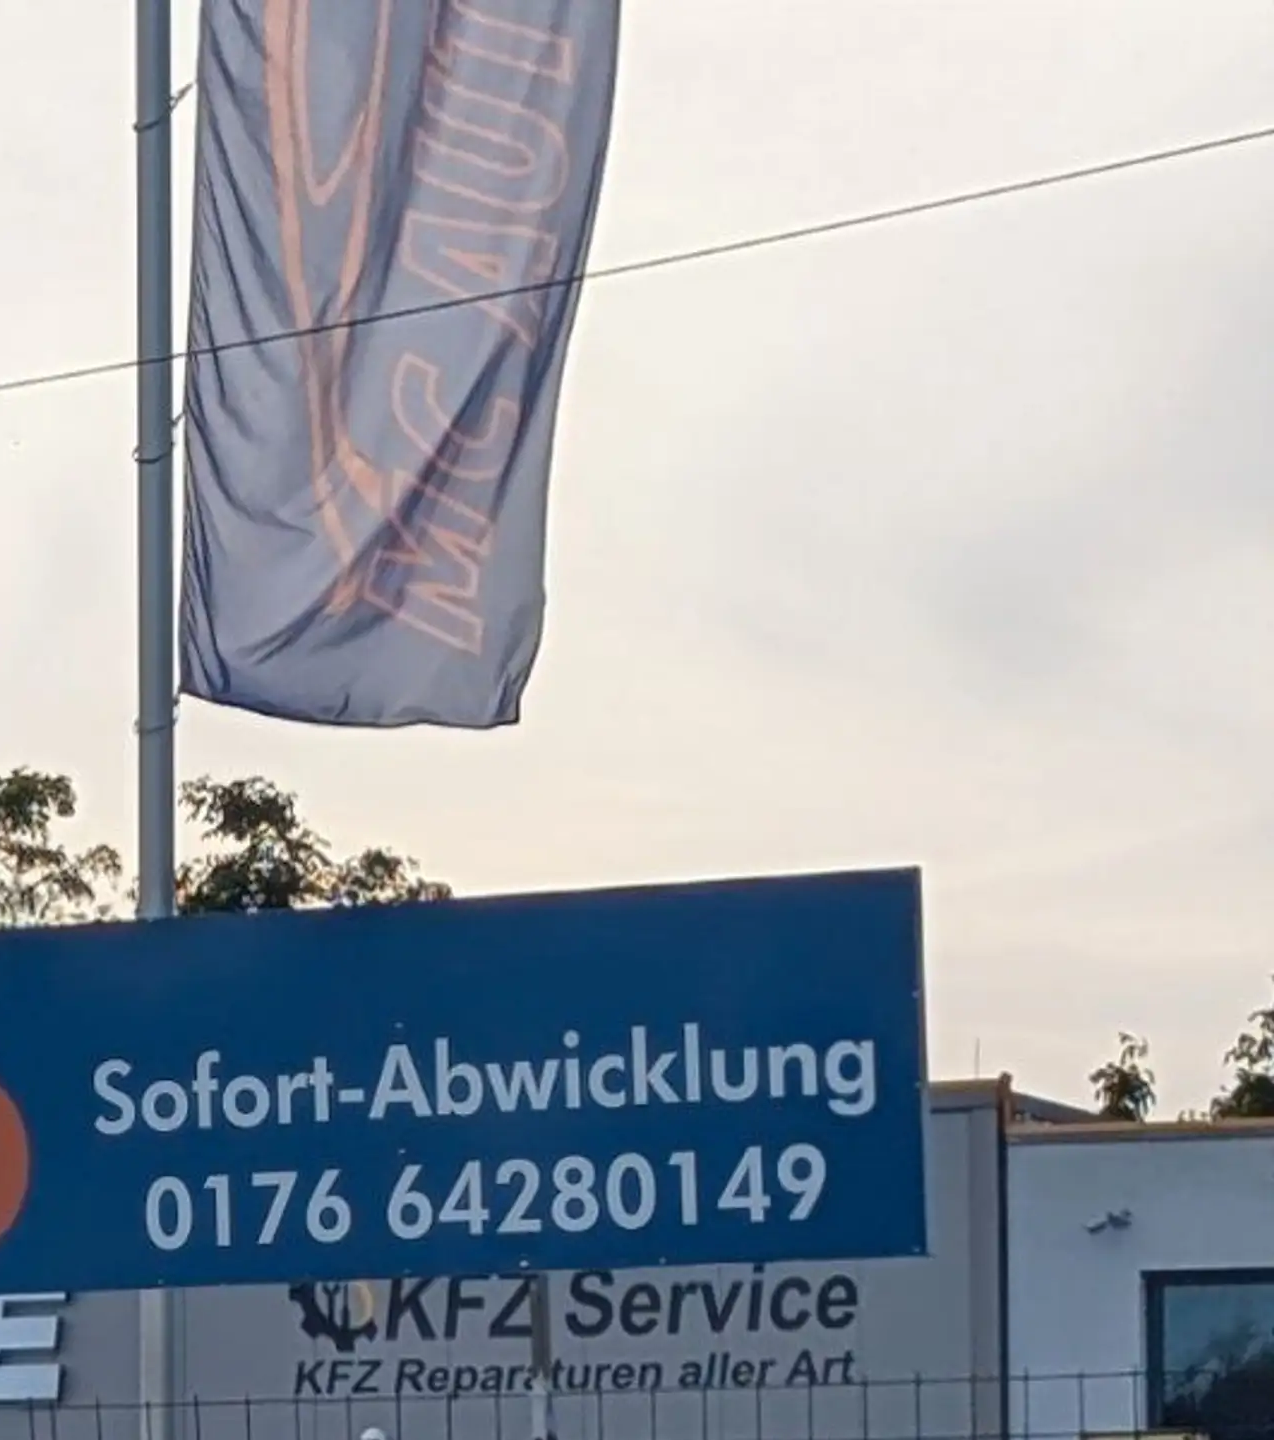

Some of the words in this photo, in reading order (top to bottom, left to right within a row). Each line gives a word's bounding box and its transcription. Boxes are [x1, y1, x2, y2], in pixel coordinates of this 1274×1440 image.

[92, 1022, 877, 1136] Sofort-Abwicklung
[144, 1167, 352, 1251] 0176
[386, 1142, 827, 1241] 64280149
[385, 1273, 538, 1341] KFZ
[565, 1264, 860, 1338] Service
[293, 1359, 382, 1396] KFZ
[677, 1352, 776, 1390] aller
[785, 1348, 856, 1387] Art
